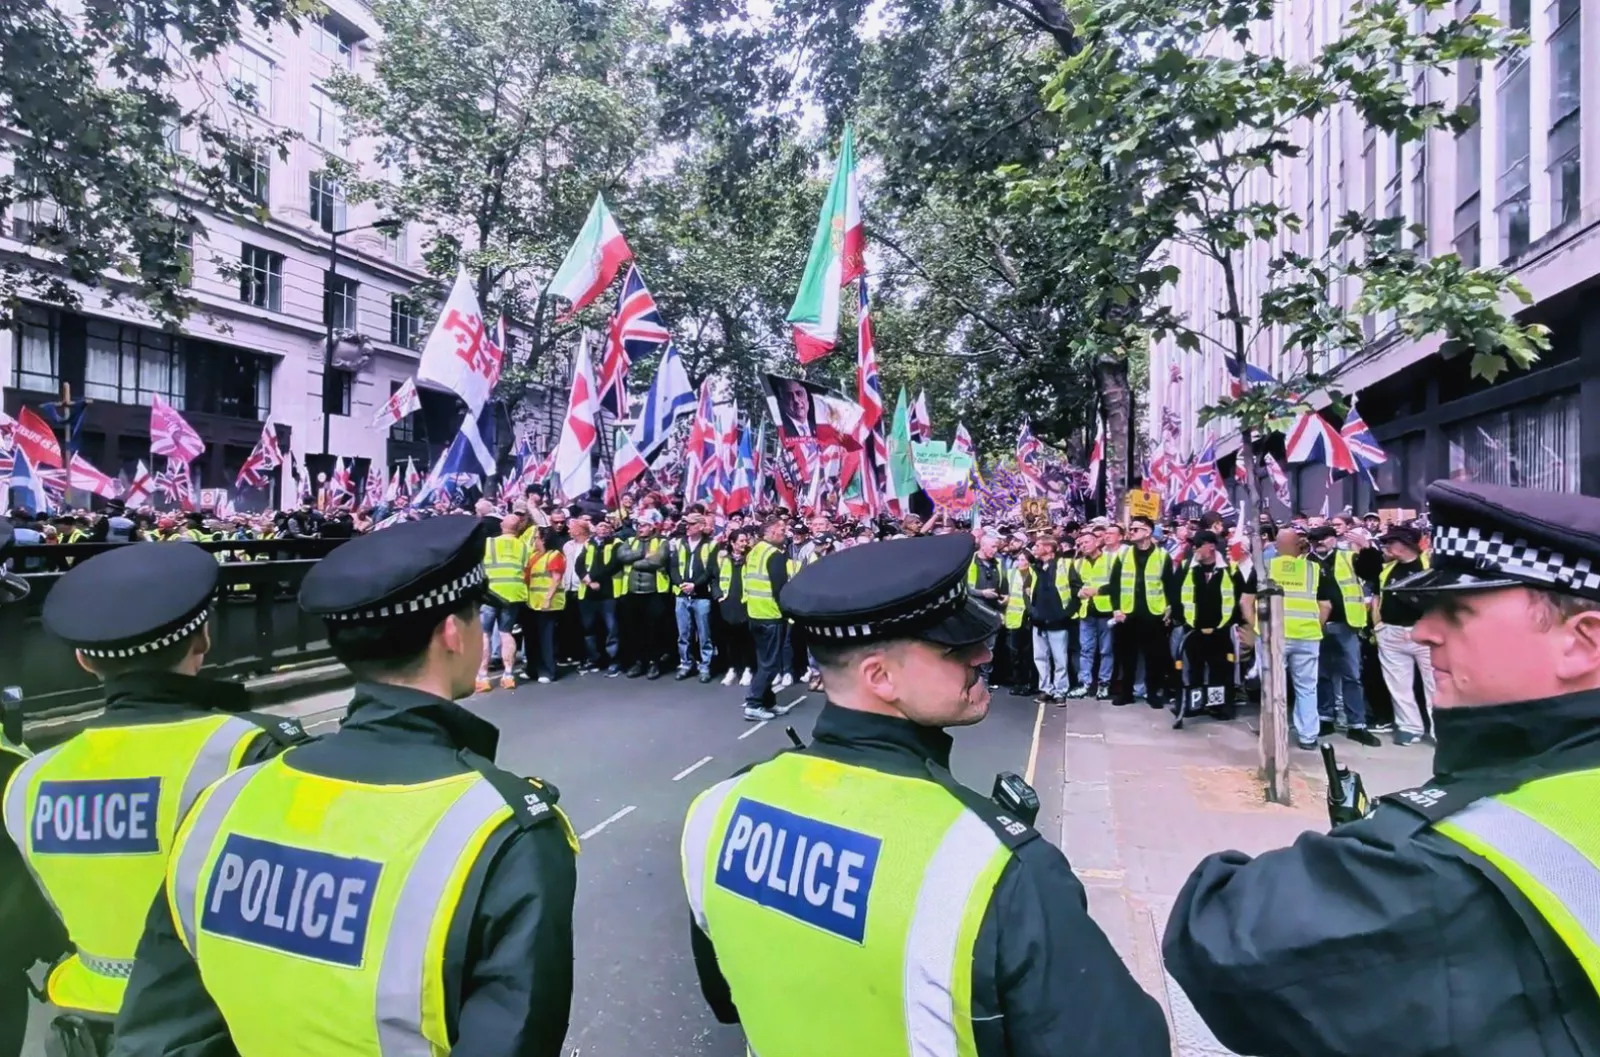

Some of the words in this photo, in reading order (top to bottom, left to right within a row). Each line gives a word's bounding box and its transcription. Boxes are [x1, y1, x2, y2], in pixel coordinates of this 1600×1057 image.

[1191, 690, 1202, 708] P
[36, 793, 150, 841] POLICE
[210, 852, 366, 944] POLICE
[722, 814, 866, 919] POLICE
